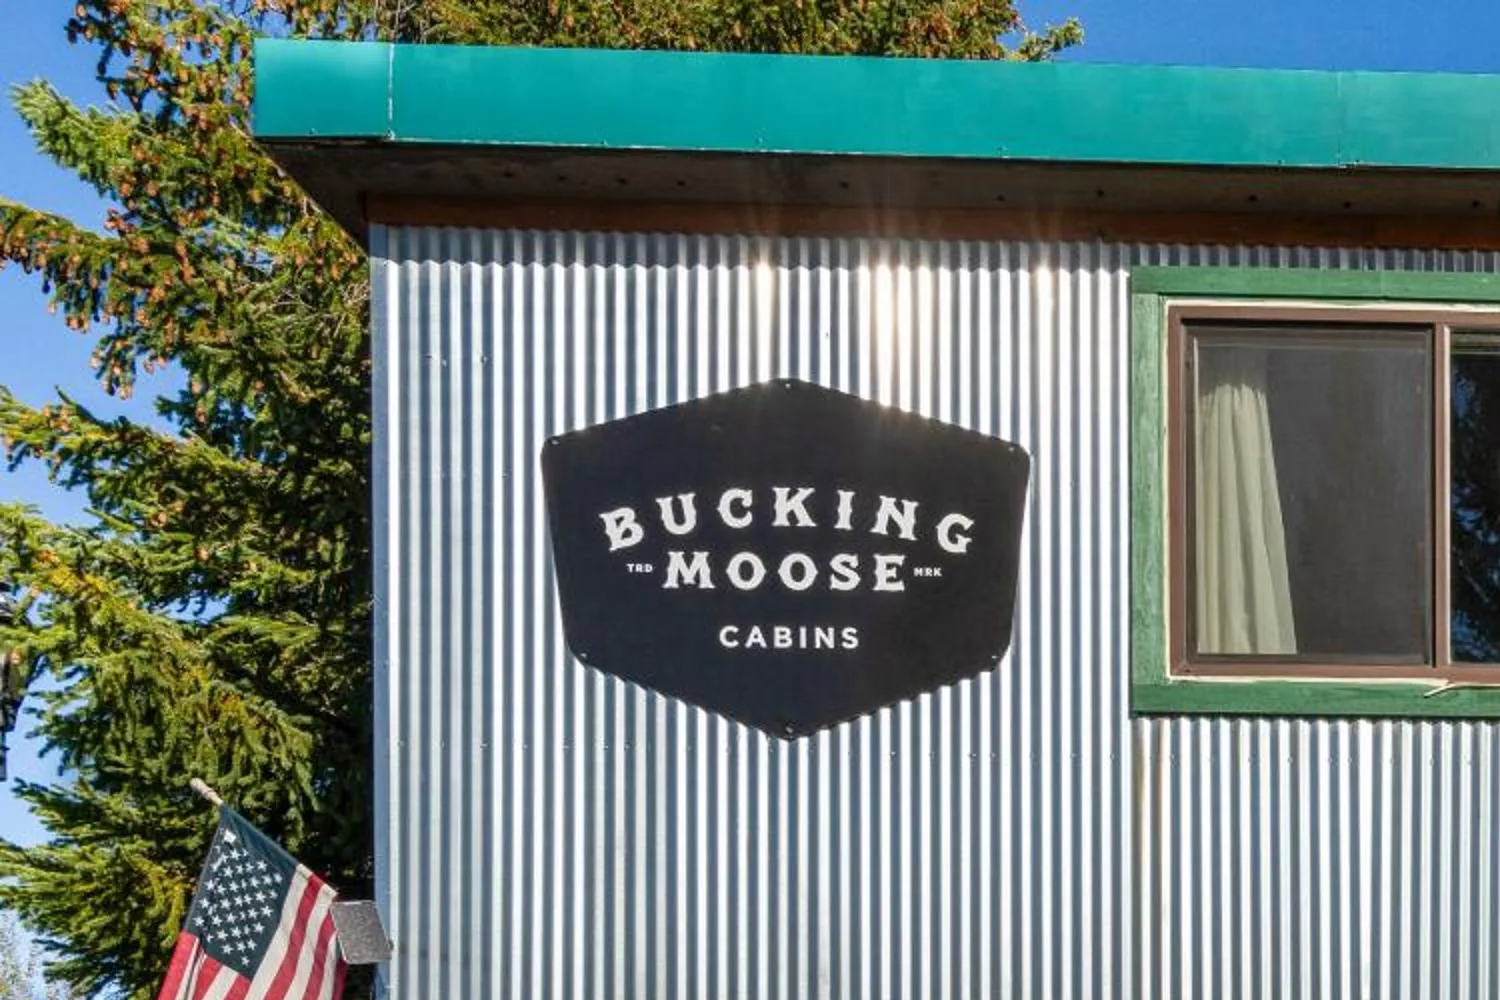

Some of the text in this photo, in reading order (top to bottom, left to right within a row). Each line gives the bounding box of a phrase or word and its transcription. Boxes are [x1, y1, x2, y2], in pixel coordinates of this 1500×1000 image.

[599, 486, 975, 554] BUCKING
[626, 550, 943, 593] TRD MOOSE MRK
[718, 625, 860, 650] CABINS
